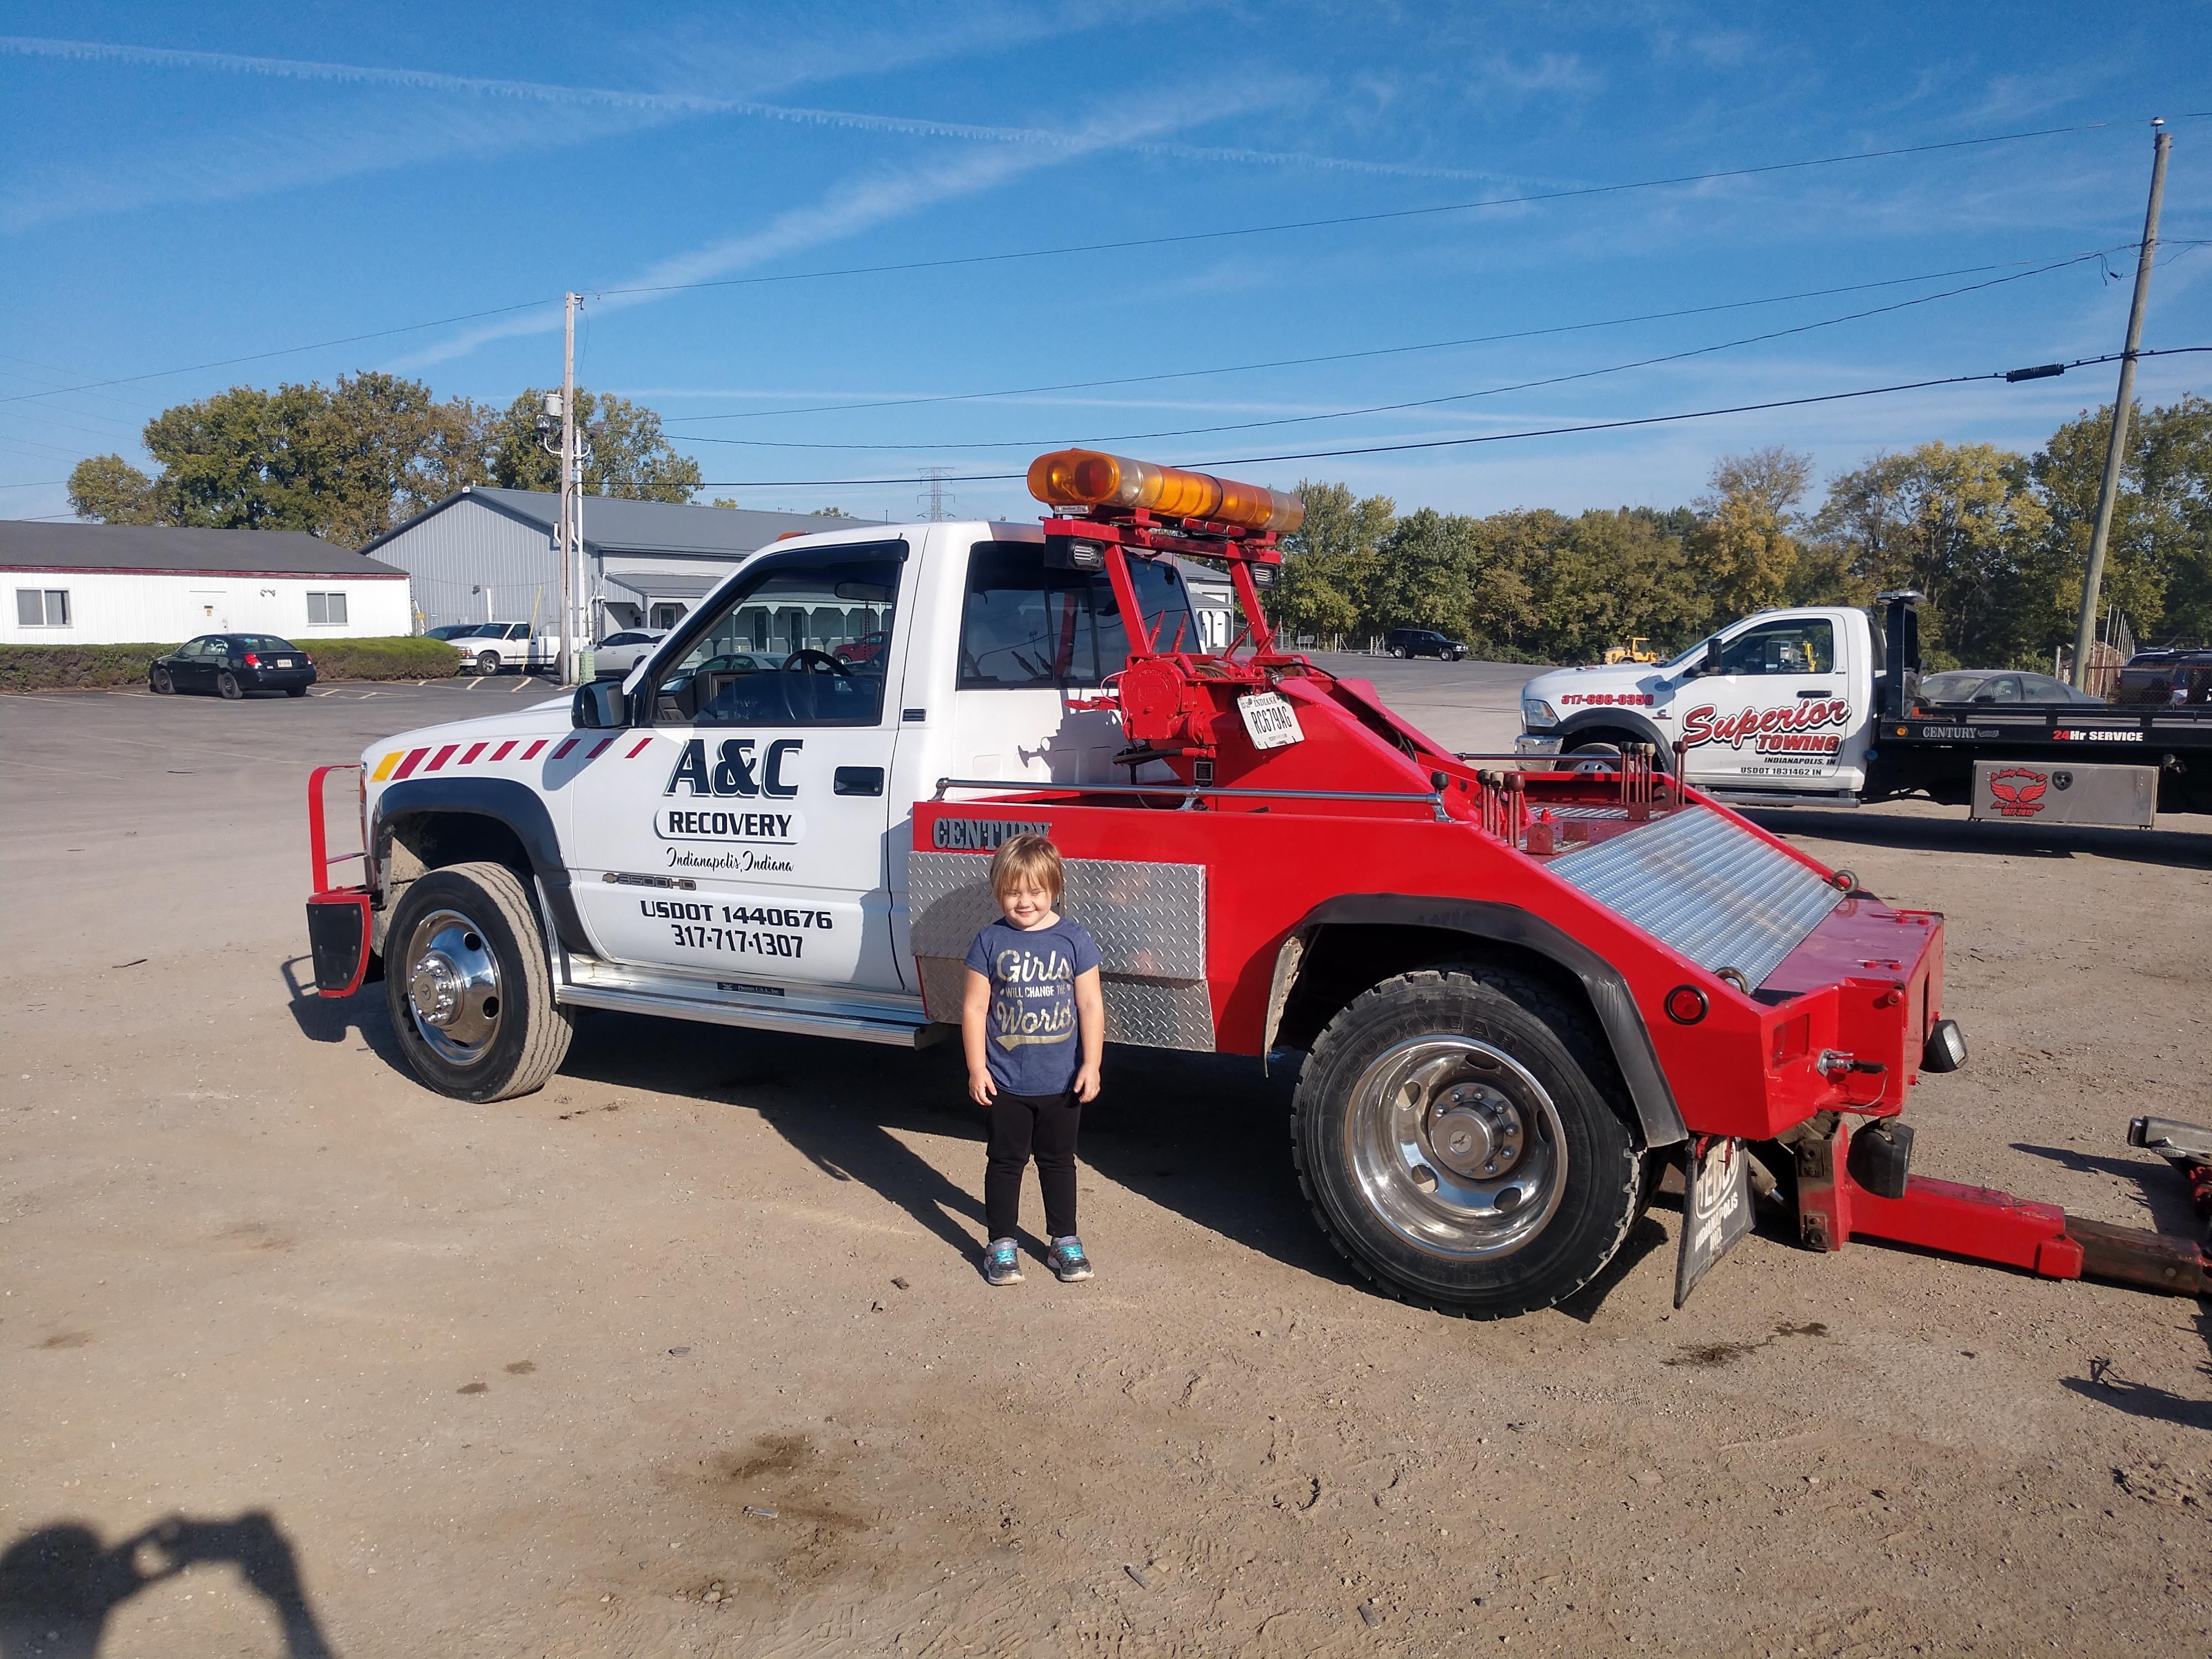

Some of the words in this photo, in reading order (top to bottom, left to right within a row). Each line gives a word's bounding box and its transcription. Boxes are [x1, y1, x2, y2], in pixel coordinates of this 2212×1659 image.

[1253, 696, 1277, 707] INDIANA
[1250, 706, 1292, 734] RC679AG
[1682, 699, 1848, 746] Superior
[1923, 727, 1976, 738] CENTURY
[1758, 734, 1840, 751] TOWING
[2053, 730, 2086, 740] 24Hr
[2089, 731, 2143, 742] SERVICE
[663, 739, 804, 799] A&C
[669, 811, 792, 837] RECOVERY
[640, 900, 713, 921] USDOT
[722, 906, 833, 929] 1440676
[997, 950, 1071, 983] Girls
[1005, 987, 1023, 998] WILL
[1025, 985, 1055, 998] CHANGE
[1057, 984, 1066, 995] THE
[997, 999, 1072, 1034] World
[1695, 1191, 1738, 1253] INDIANAPOLIS
